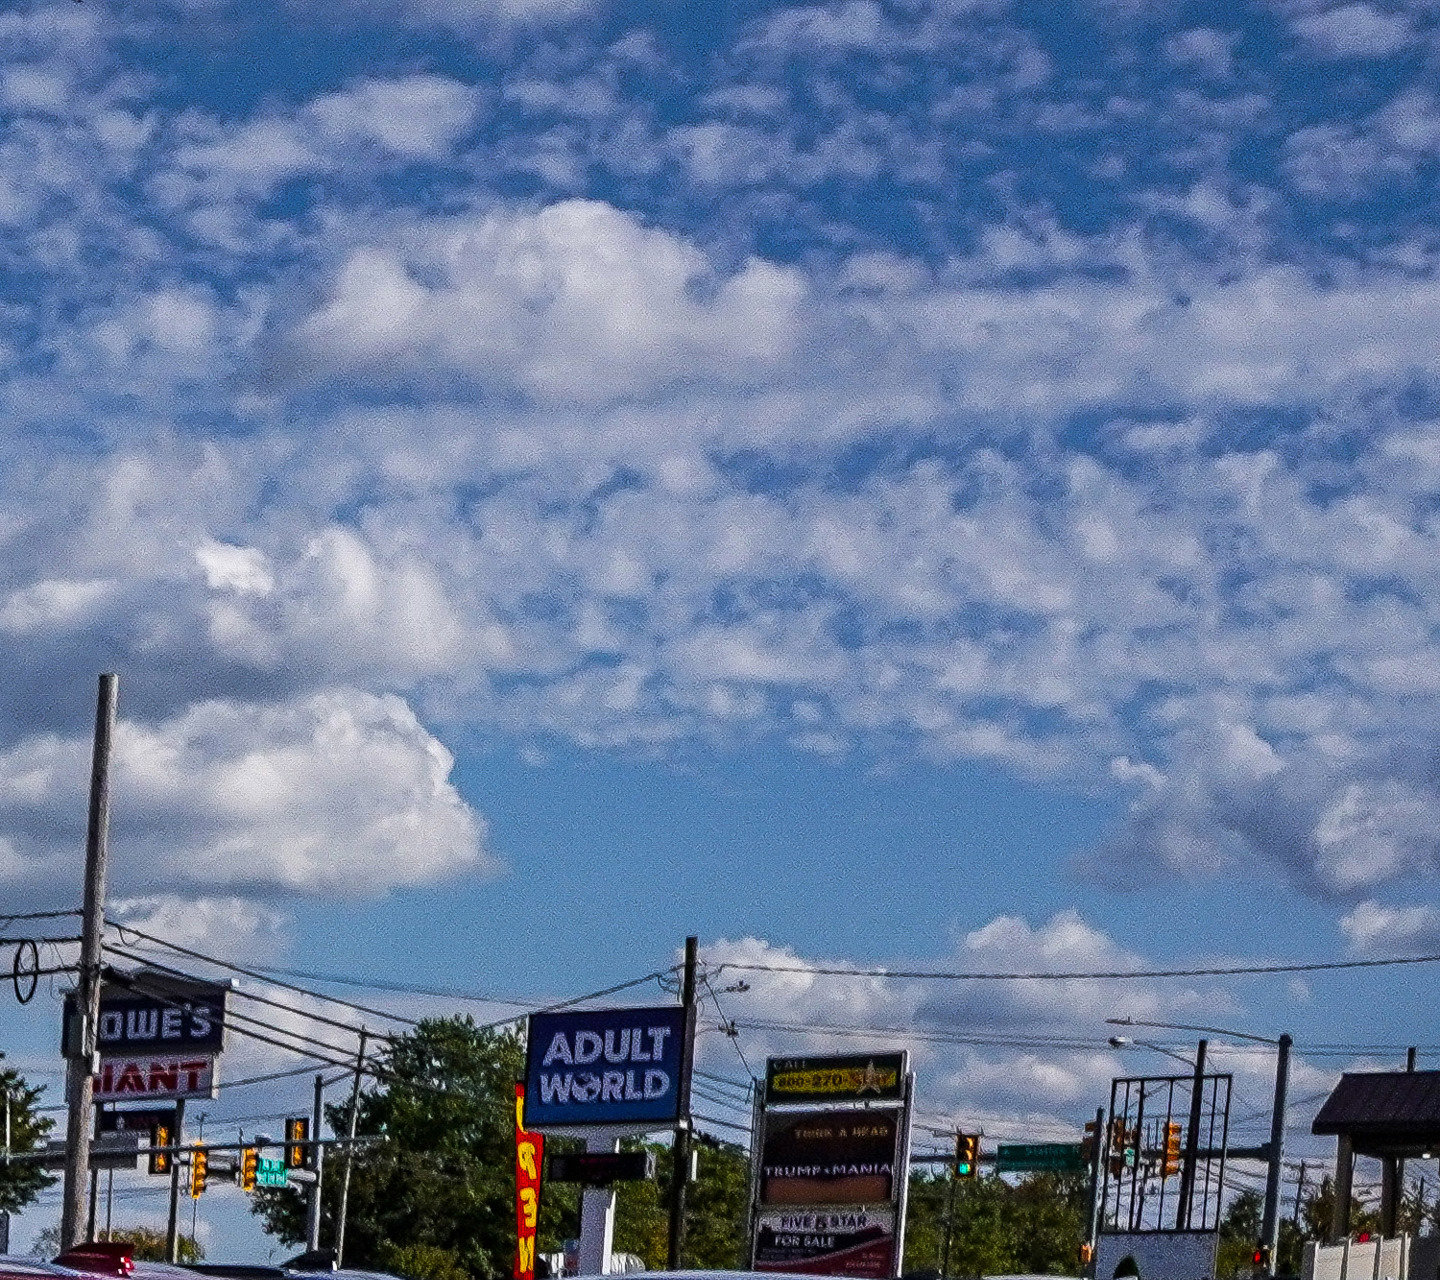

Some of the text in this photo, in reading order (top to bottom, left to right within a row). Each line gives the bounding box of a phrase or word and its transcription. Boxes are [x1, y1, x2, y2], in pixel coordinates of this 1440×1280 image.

[100, 1003, 212, 1041] OWE'S
[542, 1026, 671, 1067] ADULT
[540, 1068, 670, 1104] WORLD
[832, 1163, 892, 1176] MANIA
[781, 1214, 813, 1228] FIVE
[774, 1235, 835, 1248] FOR SALE
